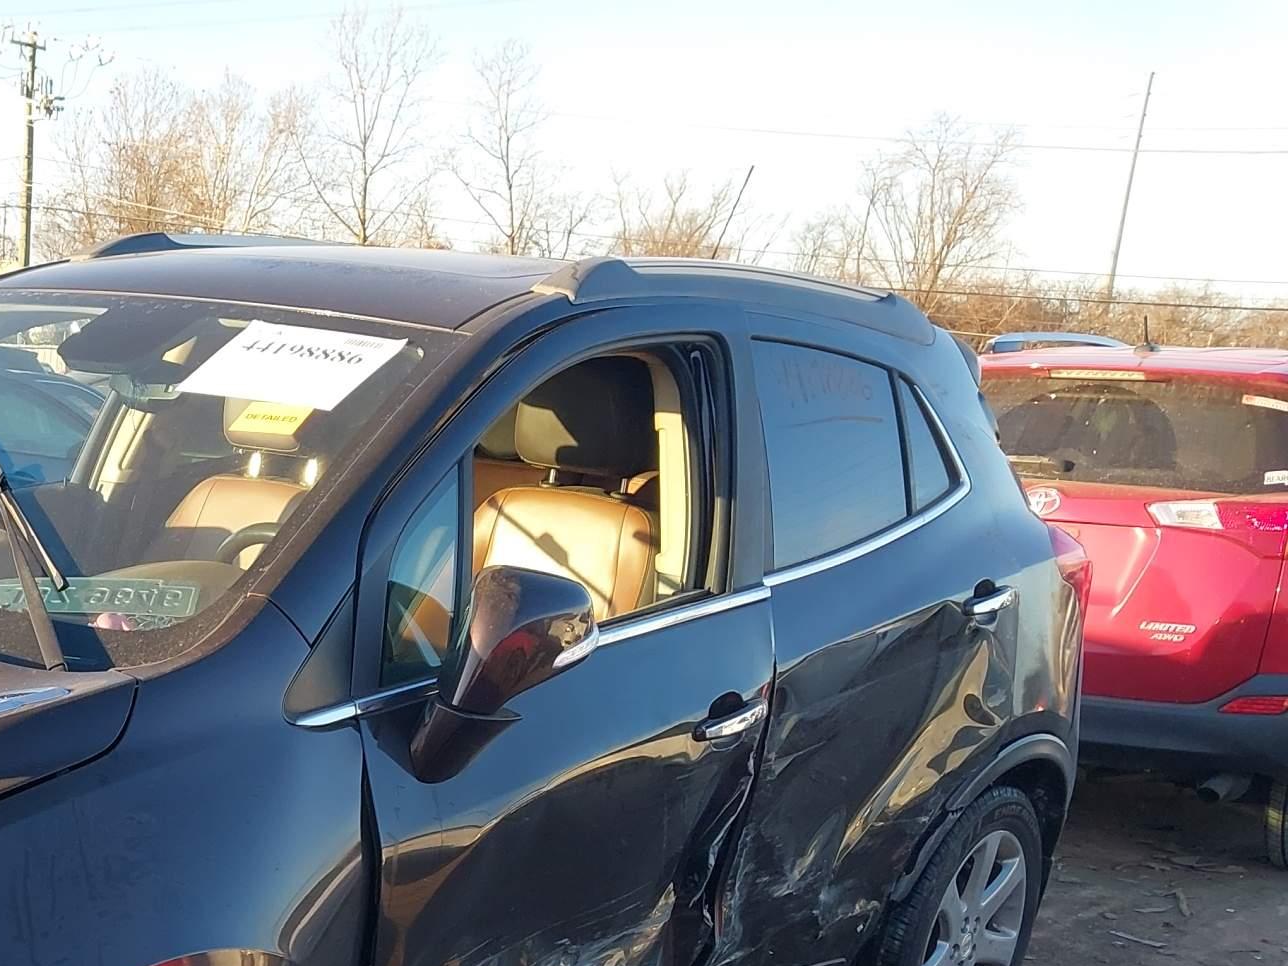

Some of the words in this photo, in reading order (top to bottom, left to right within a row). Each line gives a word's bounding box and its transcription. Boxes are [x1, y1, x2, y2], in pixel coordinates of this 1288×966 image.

[241, 339, 363, 365] 44198886
[246, 413, 298, 423] DETAILED
[1139, 620, 1197, 634] LIMITED
[1150, 633, 1185, 642] AWD
